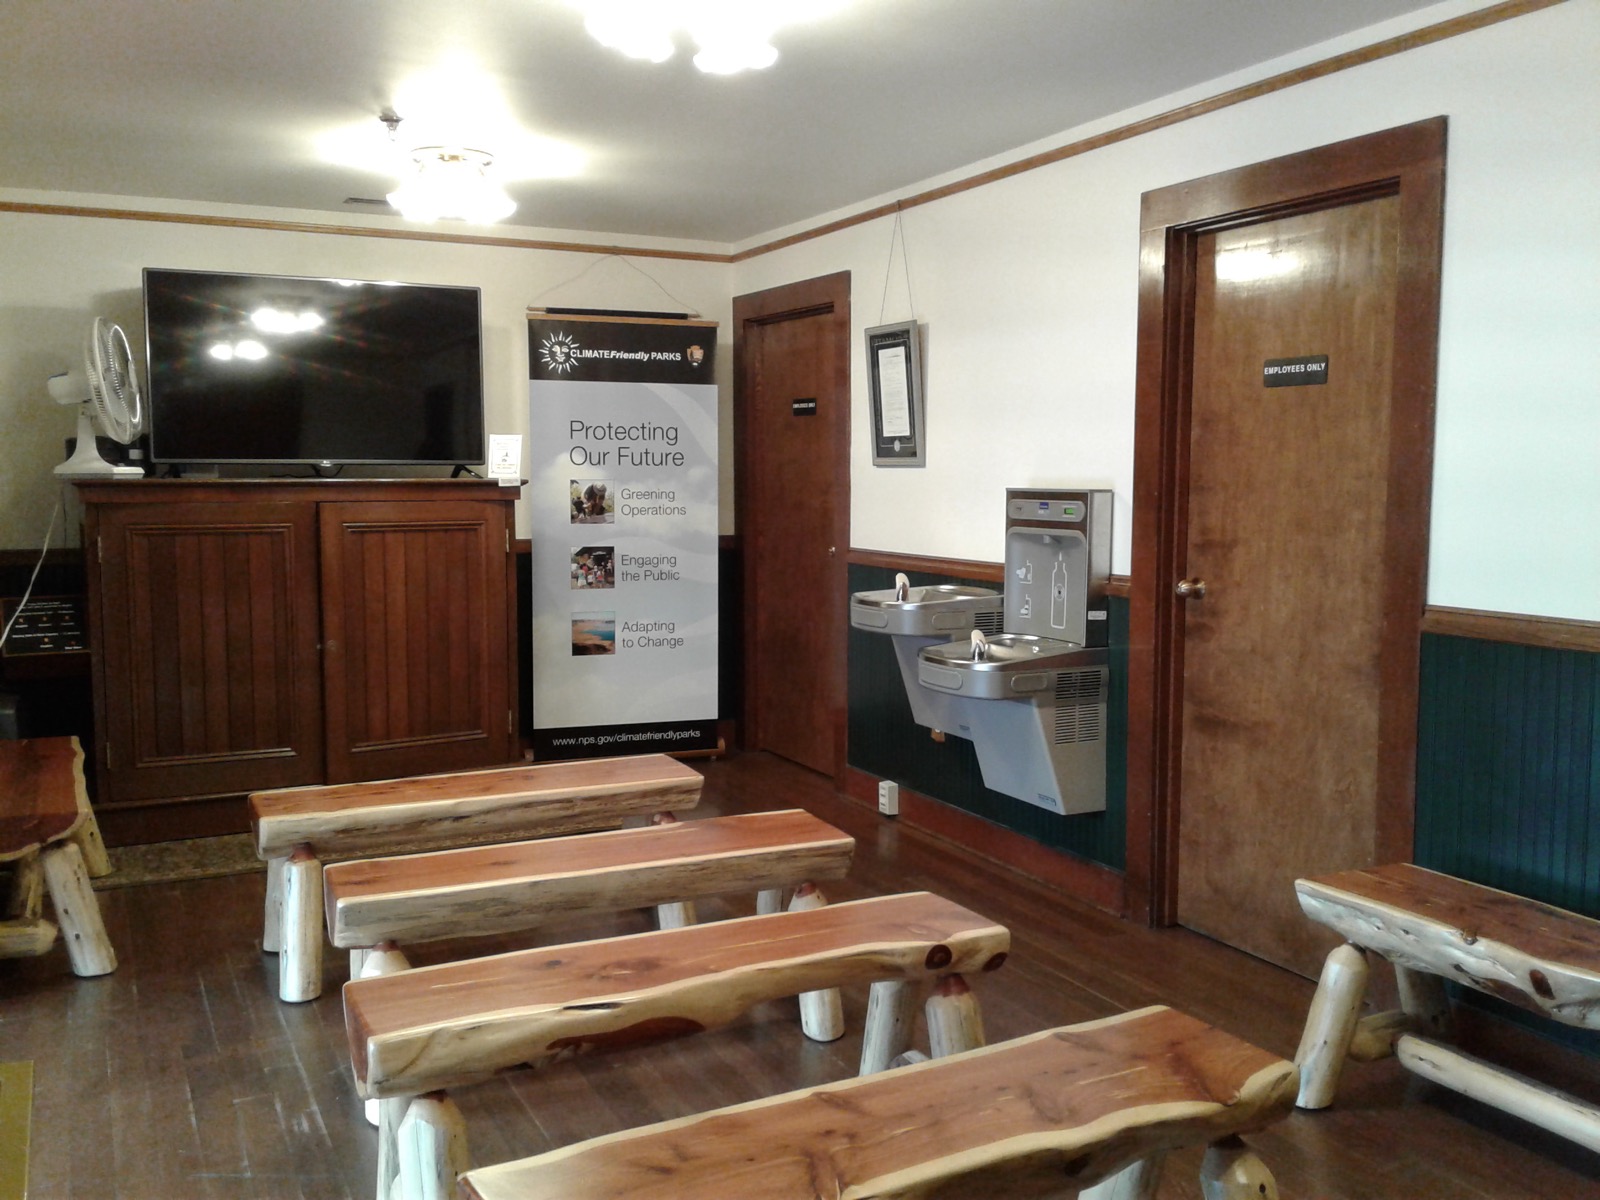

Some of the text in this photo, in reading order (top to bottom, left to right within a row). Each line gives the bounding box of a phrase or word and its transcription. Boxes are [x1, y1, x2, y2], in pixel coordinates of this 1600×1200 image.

[651, 352, 681, 361] PARKS
[1264, 362, 1326, 375] EMPLOYEES ONLY
[570, 420, 678, 446] Protecting
[570, 446, 684, 467] Our Future
[621, 488, 676, 502] Greening
[621, 504, 687, 517] Operations
[621, 554, 677, 568] Engaging
[621, 571, 680, 581] the Public
[622, 621, 675, 633] Adapting
[622, 636, 684, 649] to Change
[552, 729, 701, 746] www.nps.gov/climatefriendlyparks
